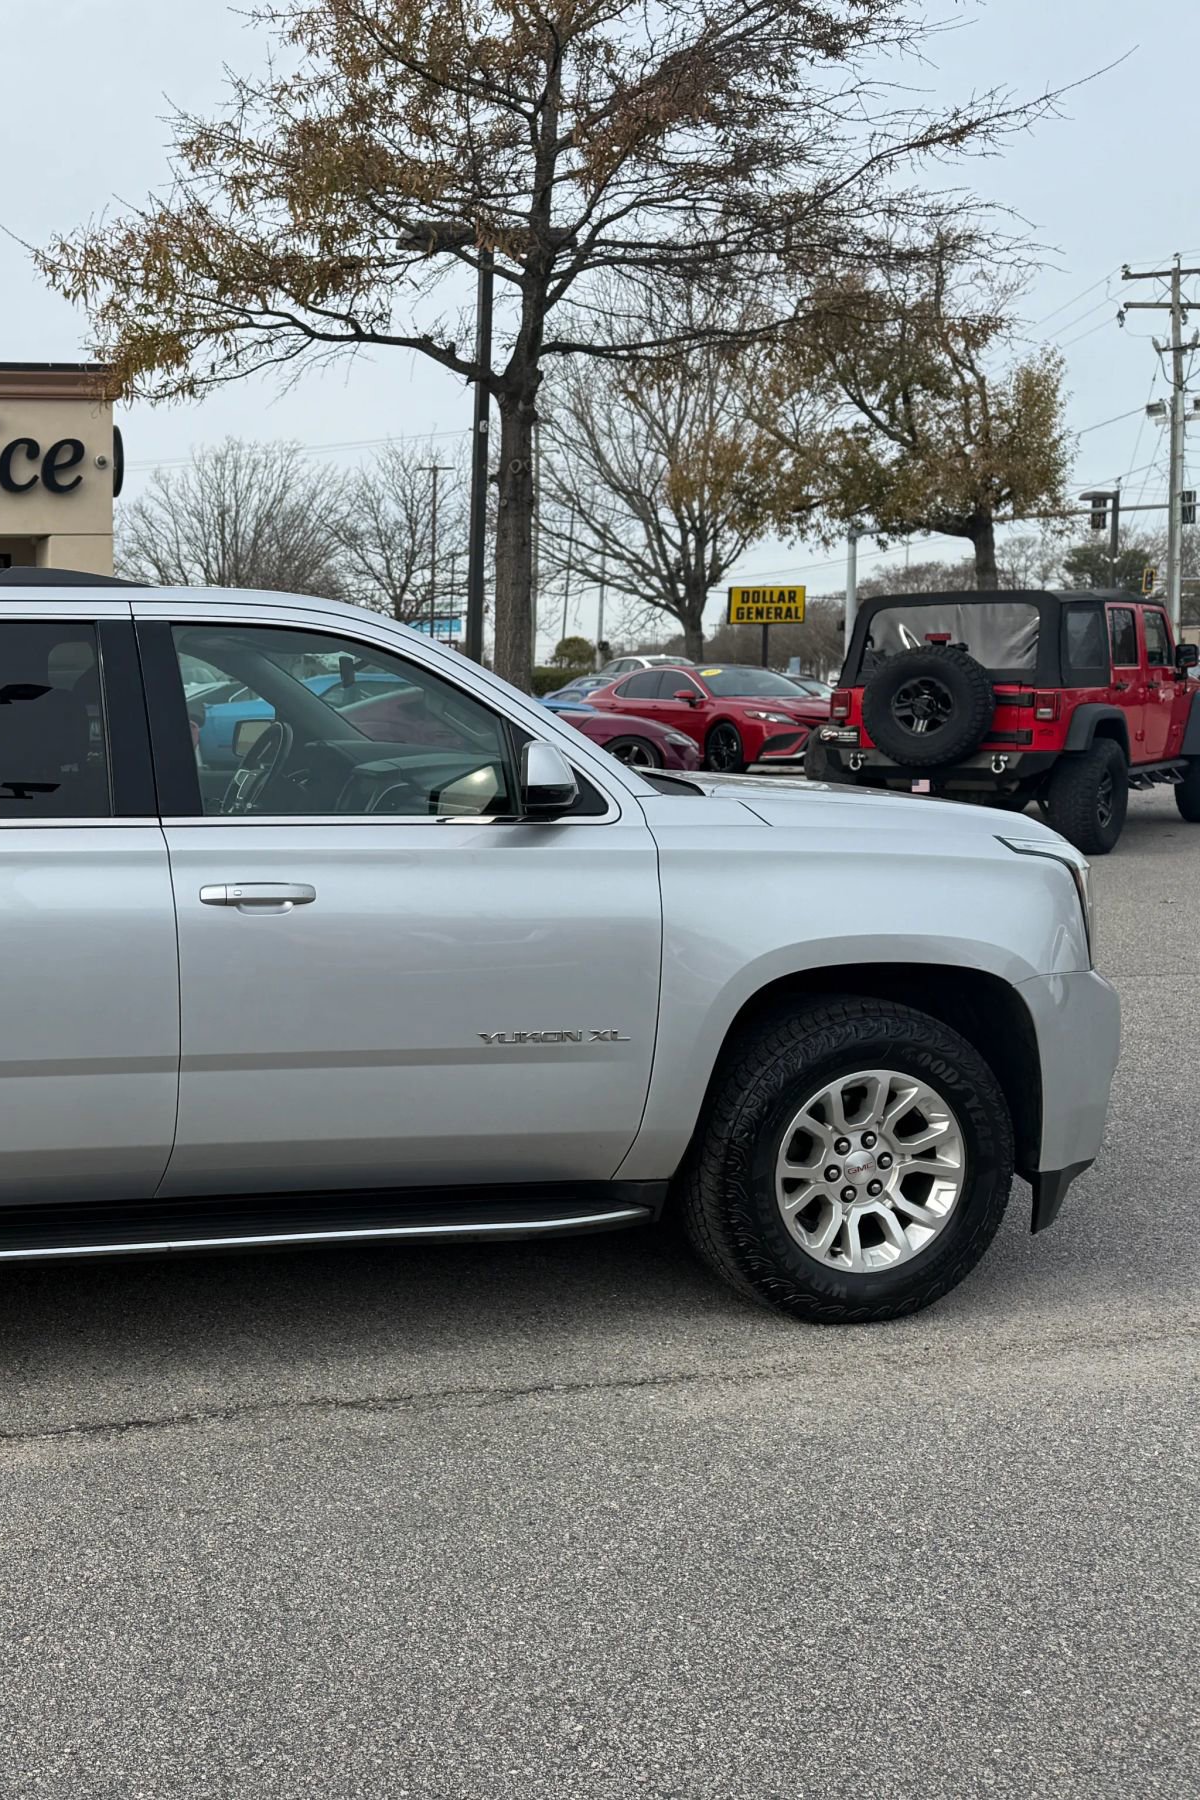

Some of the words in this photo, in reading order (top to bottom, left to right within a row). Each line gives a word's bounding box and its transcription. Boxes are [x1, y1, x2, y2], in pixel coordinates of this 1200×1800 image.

[741, 590, 797, 604] DOLLAR
[736, 606, 801, 620] GENERAL
[477, 1030, 583, 1044] YUKON
[588, 1029, 632, 1042] XL
[847, 1161, 875, 1175] GMC
